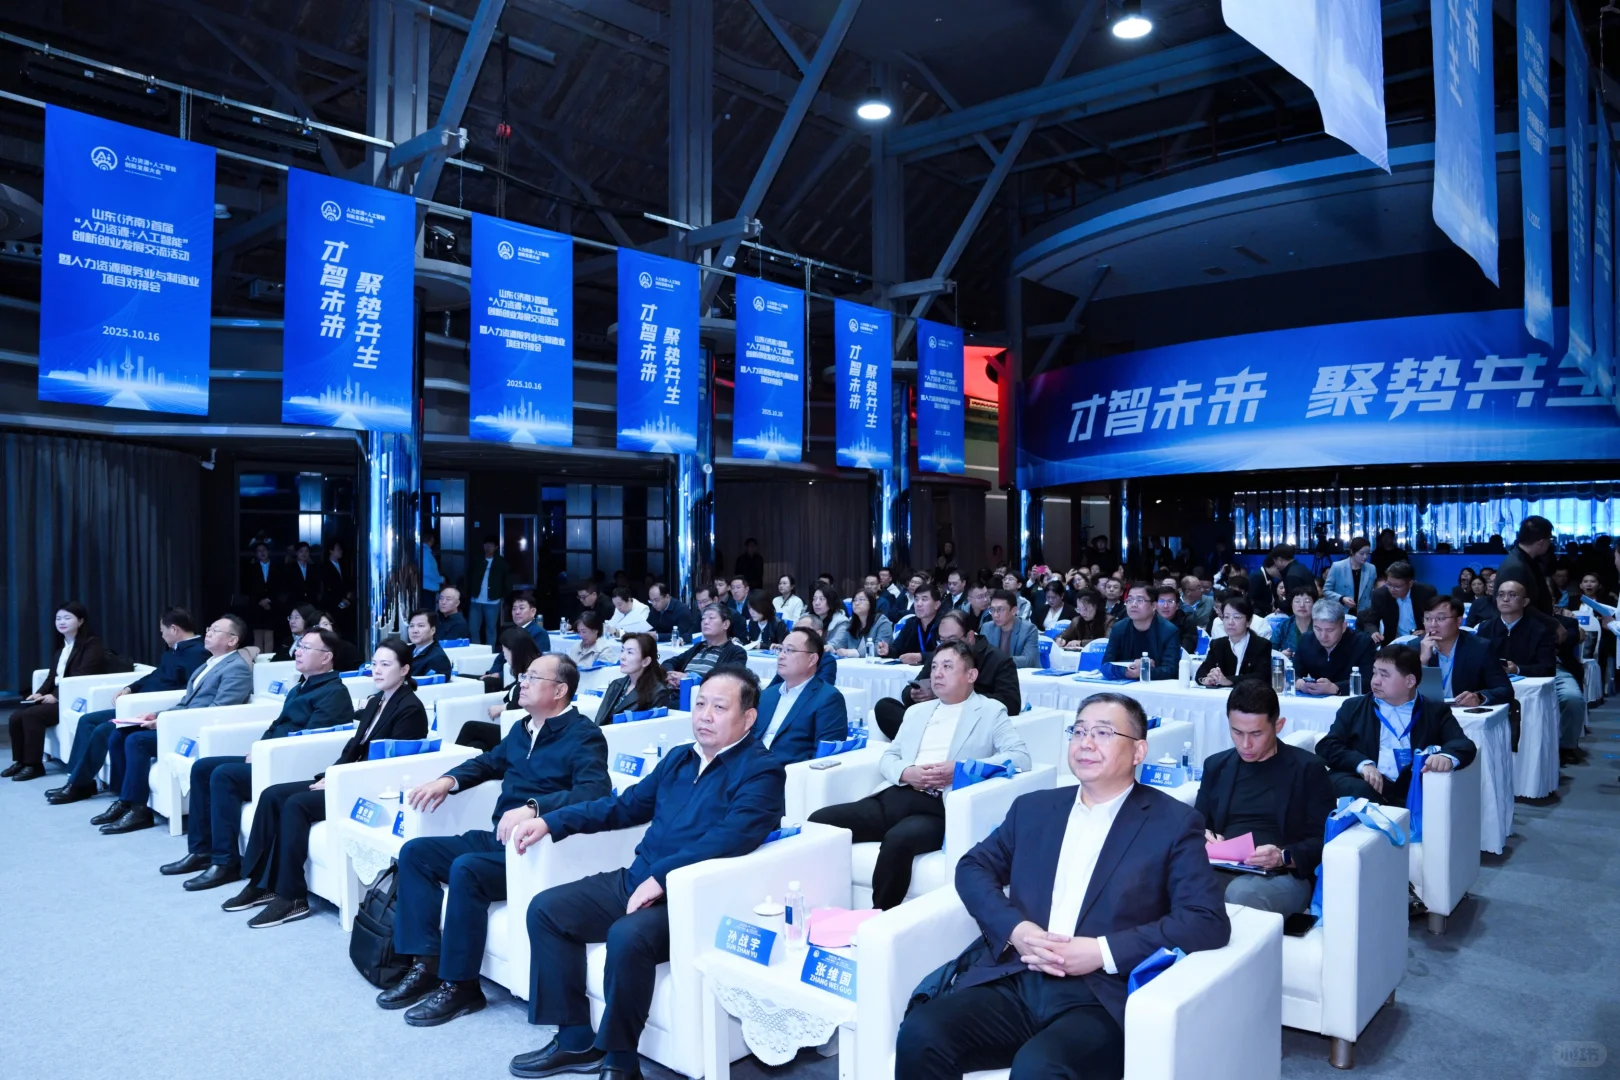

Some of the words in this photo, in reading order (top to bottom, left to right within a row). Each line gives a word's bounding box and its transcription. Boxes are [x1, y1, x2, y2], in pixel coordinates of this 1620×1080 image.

[72, 230, 190, 261] 创新创业发展交流活动
[58, 253, 200, 287] 暨人力资源服务业与制造业
[101, 273, 161, 293] 项目对接会
[320, 240, 349, 339] 才智未来
[102, 325, 160, 342] 2025.10.16
[352, 271, 384, 370] 聚势共生
[639, 303, 658, 383] 才智未来
[663, 327, 681, 405] 聚势共生
[848, 344, 862, 410] 才智未来
[506, 379, 542, 390] 2025.10.16
[865, 363, 878, 429] 聚势共生
[1067, 366, 1268, 443] 才智未来
[725, 942, 737, 951] SUN
[737, 946, 750, 956] ZHAN
[750, 951, 758, 959] YU
[727, 929, 761, 951] 孙战宇
[809, 973, 828, 987] ZHANG
[828, 980, 839, 991] WEI
[839, 985, 852, 996] GUO
[814, 961, 853, 988] 张维国
